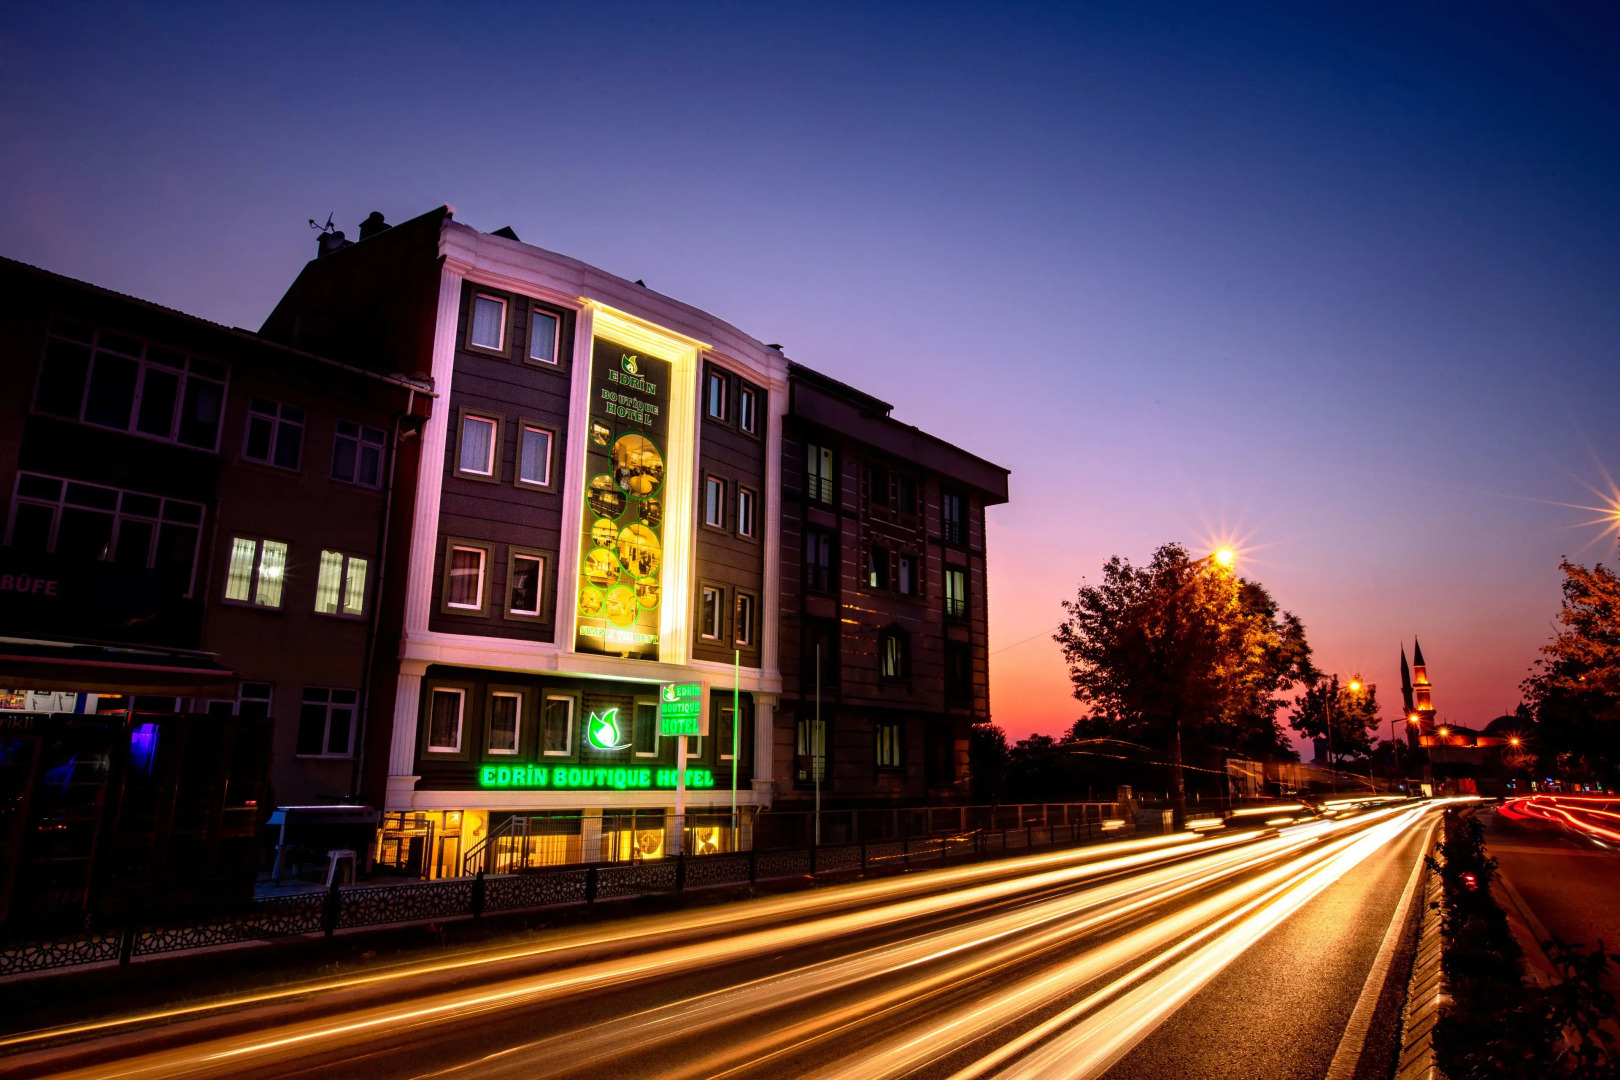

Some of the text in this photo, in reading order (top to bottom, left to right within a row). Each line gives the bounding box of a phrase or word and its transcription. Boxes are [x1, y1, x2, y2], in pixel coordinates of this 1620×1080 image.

[606, 402, 652, 425] HOTEL
[0, 573, 58, 596] BÜFE
[661, 701, 700, 714] BOUTIQUE
[660, 717, 699, 734] HOTEL
[554, 769, 650, 788] BOUTIQUE
